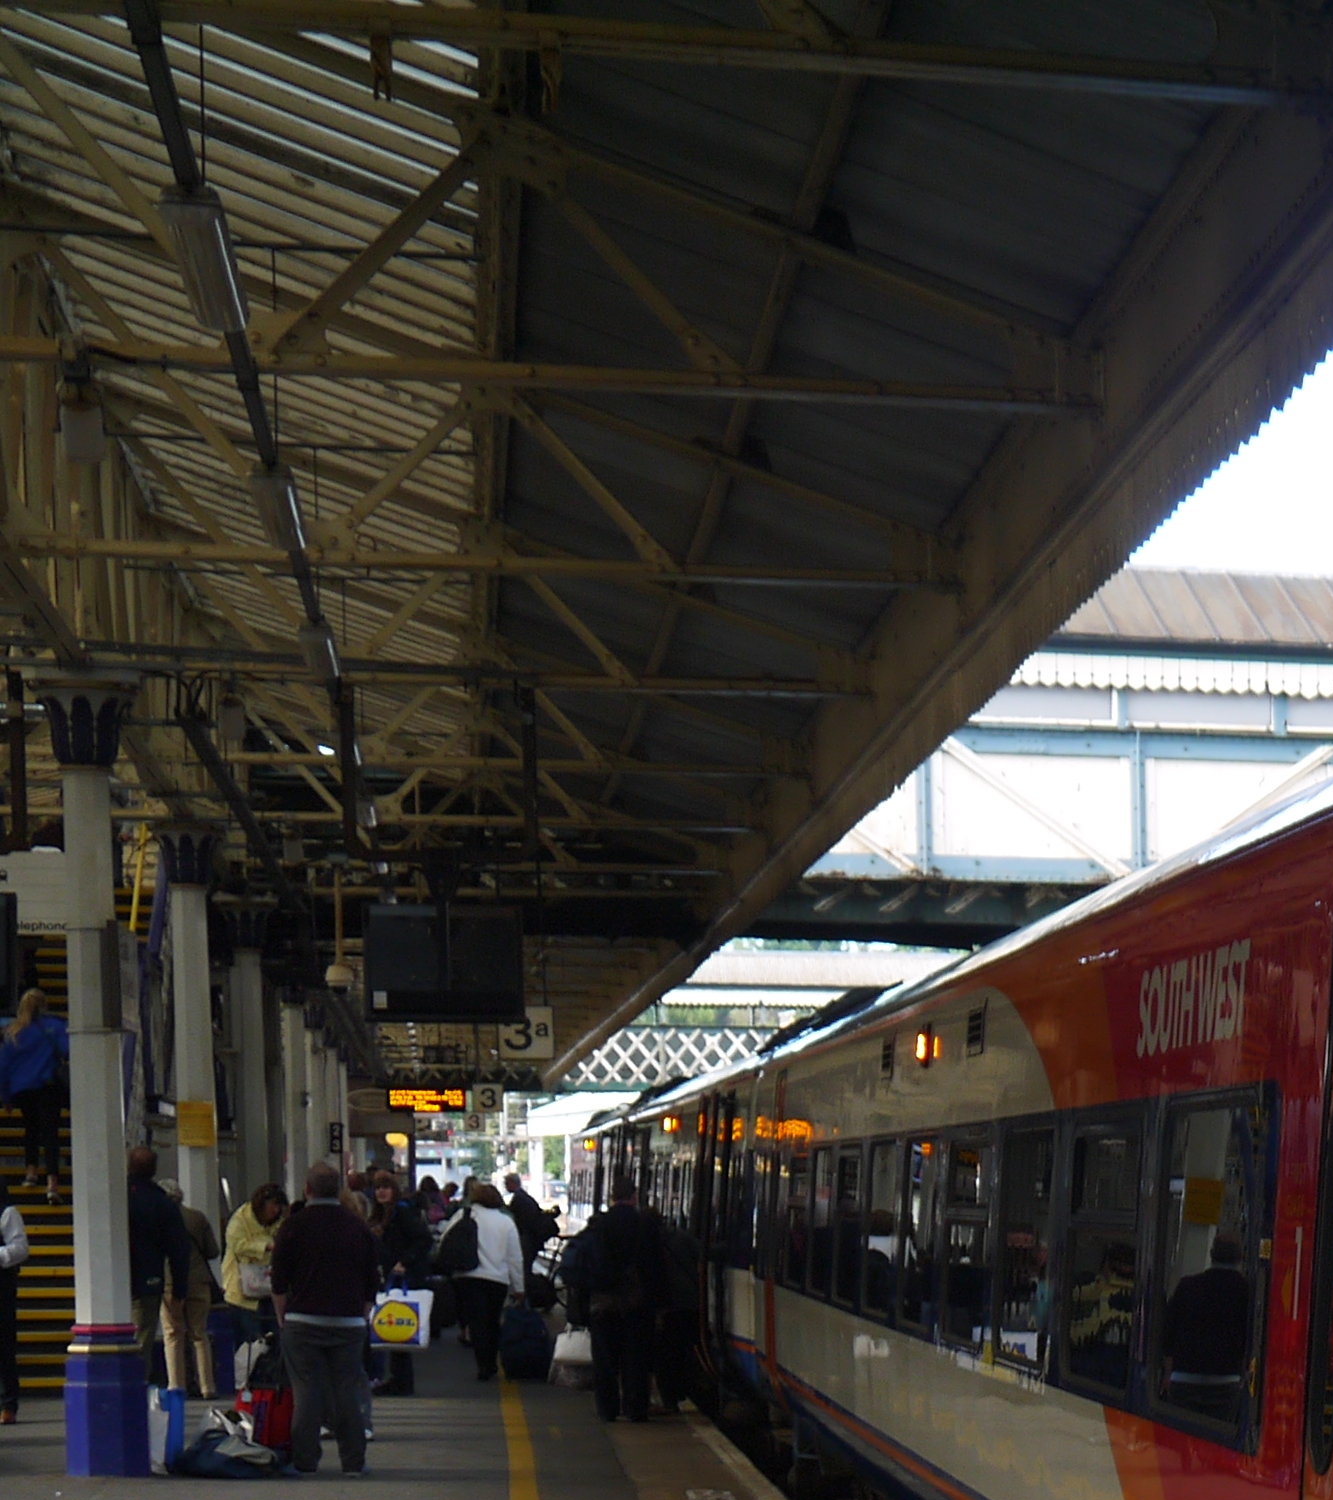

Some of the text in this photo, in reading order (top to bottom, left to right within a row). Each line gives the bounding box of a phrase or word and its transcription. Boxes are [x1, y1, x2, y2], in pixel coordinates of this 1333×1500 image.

[19, 921, 66, 931] lephon
[1136, 938, 1251, 1058] SOUTH WEST
[503, 1018, 548, 1049] 3a
[480, 1088, 496, 1109] 3
[467, 1115, 480, 1130] 3
